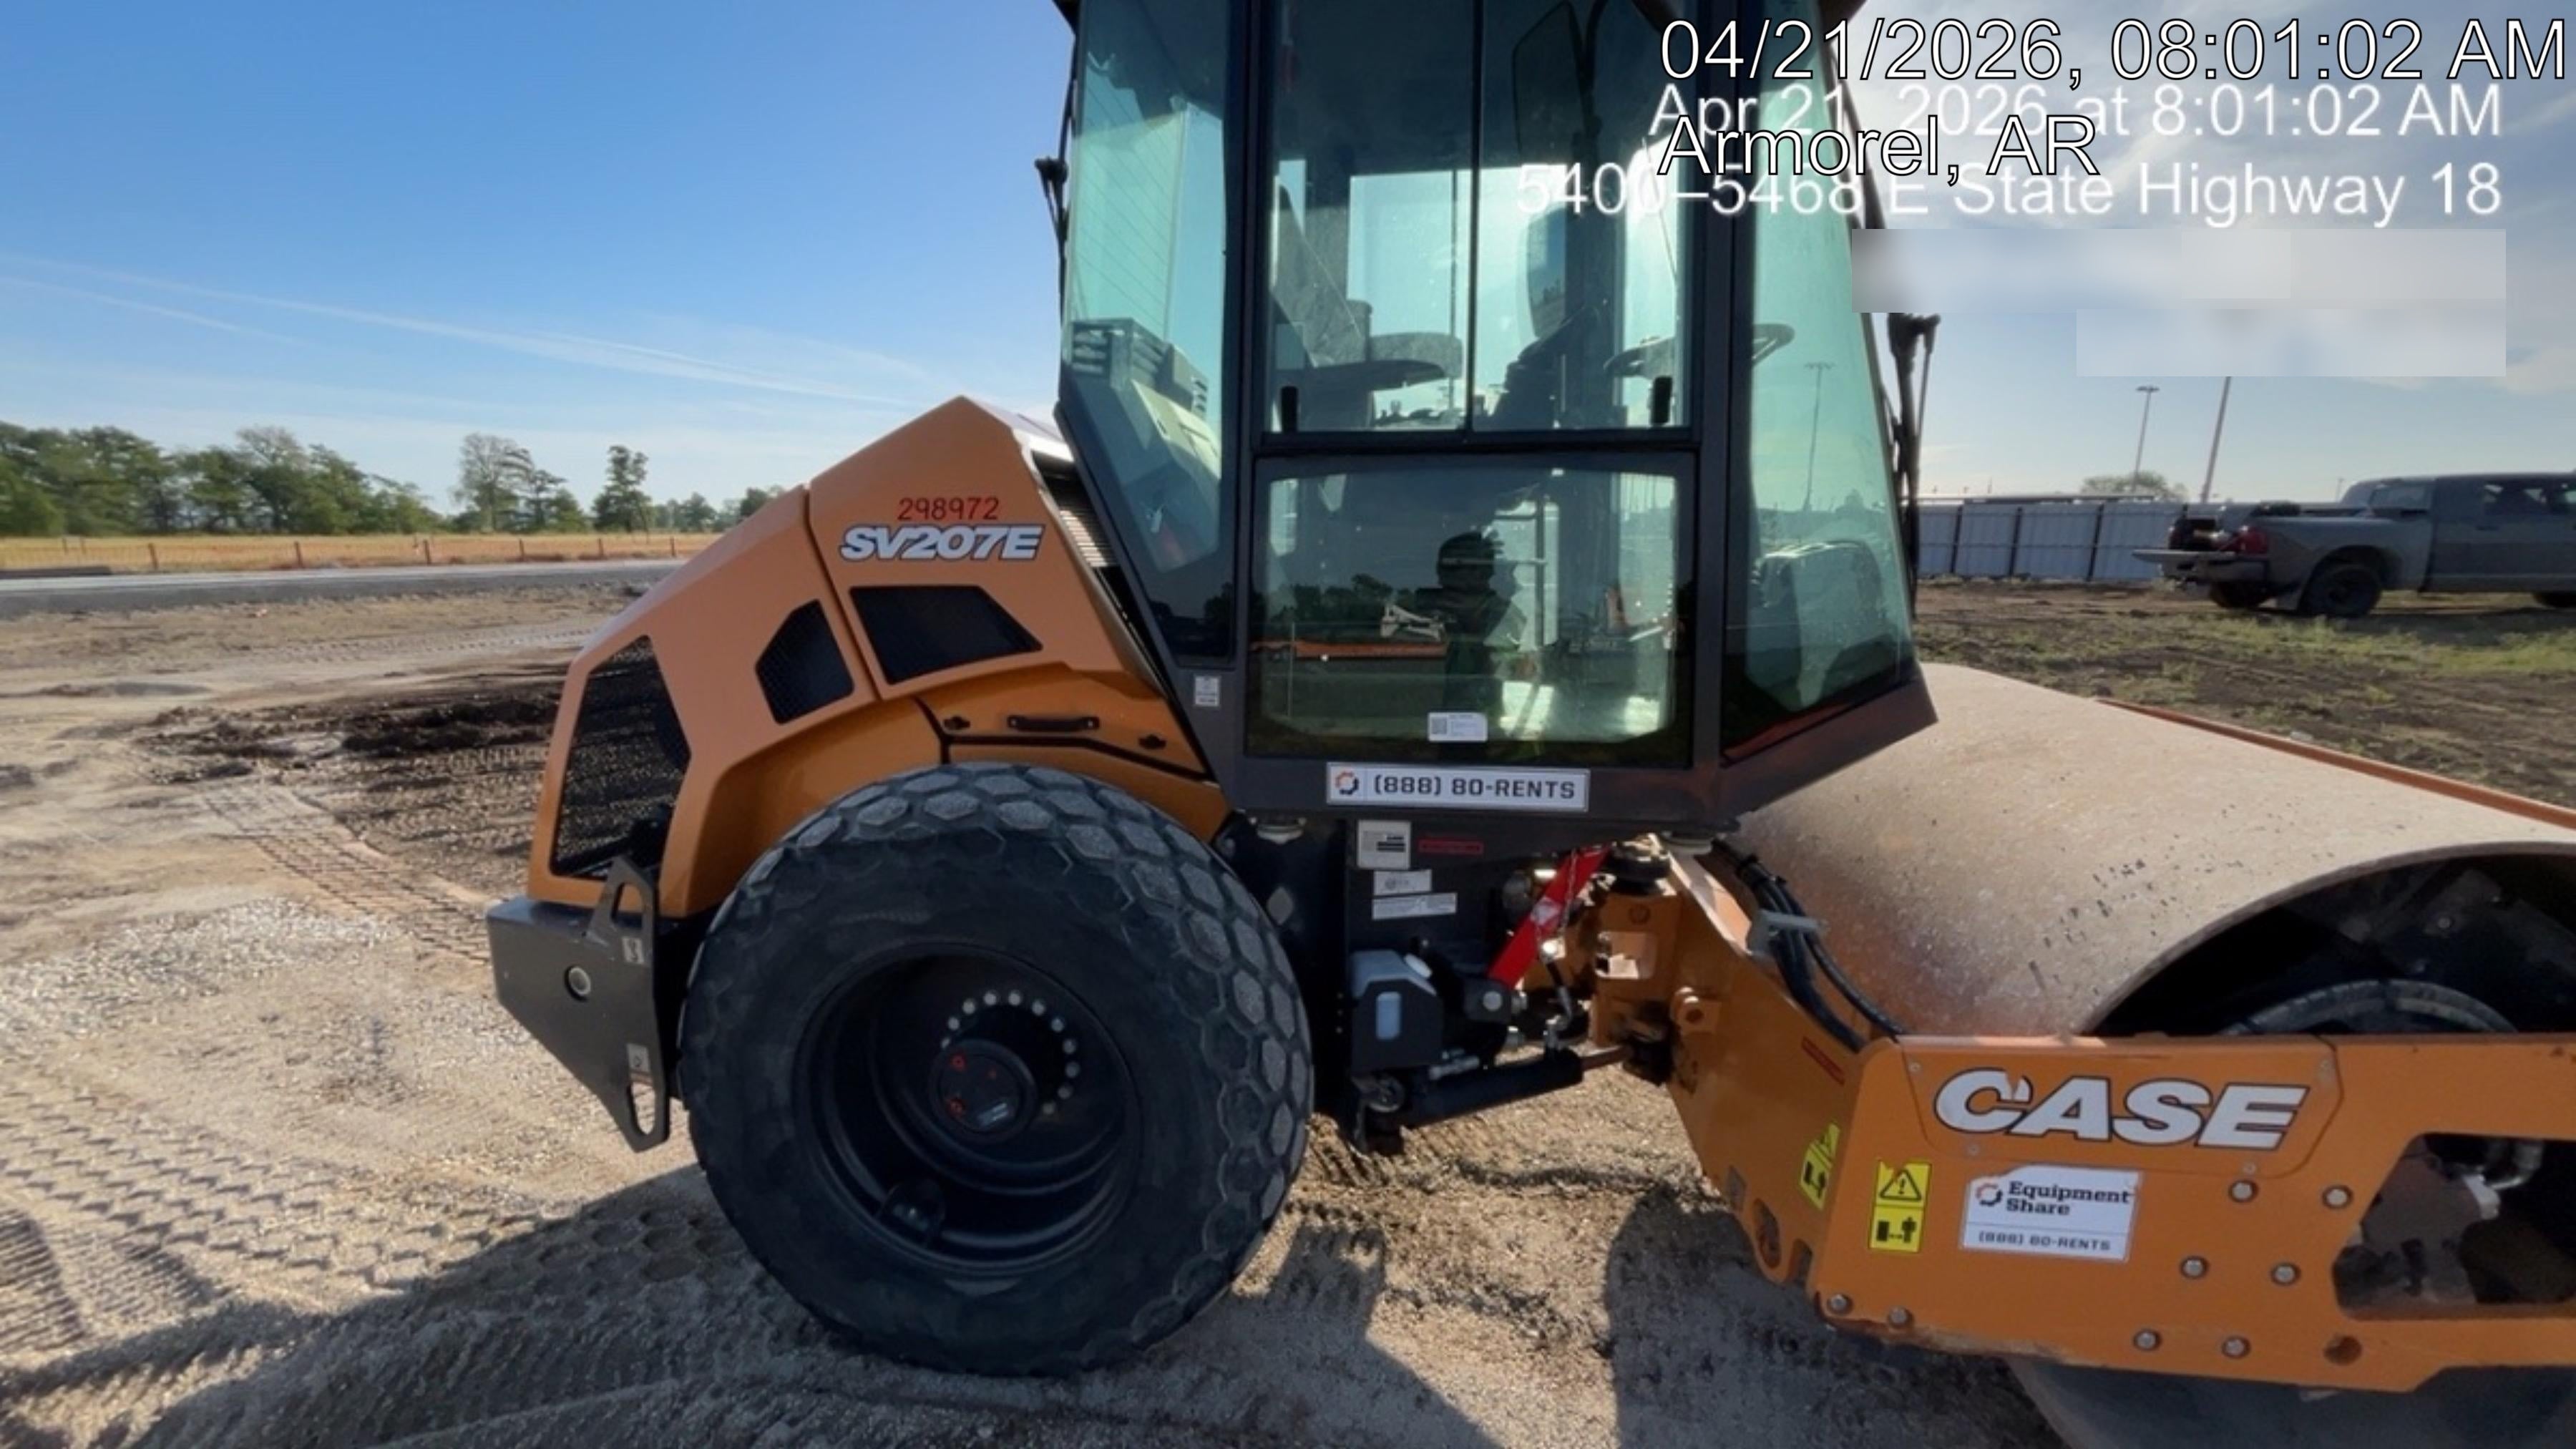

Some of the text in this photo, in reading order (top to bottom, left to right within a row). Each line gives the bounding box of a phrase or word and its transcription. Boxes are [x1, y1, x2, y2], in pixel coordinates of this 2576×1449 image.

[897, 497, 1000, 521] 298972
[838, 523, 1045, 561] SV207E
[1373, 774, 1576, 799] (888) 80-RENTS
[1933, 1067, 2309, 1150] CASE
[2008, 1181, 2130, 1204] Equipment
[2006, 1198, 2071, 1216] Share
